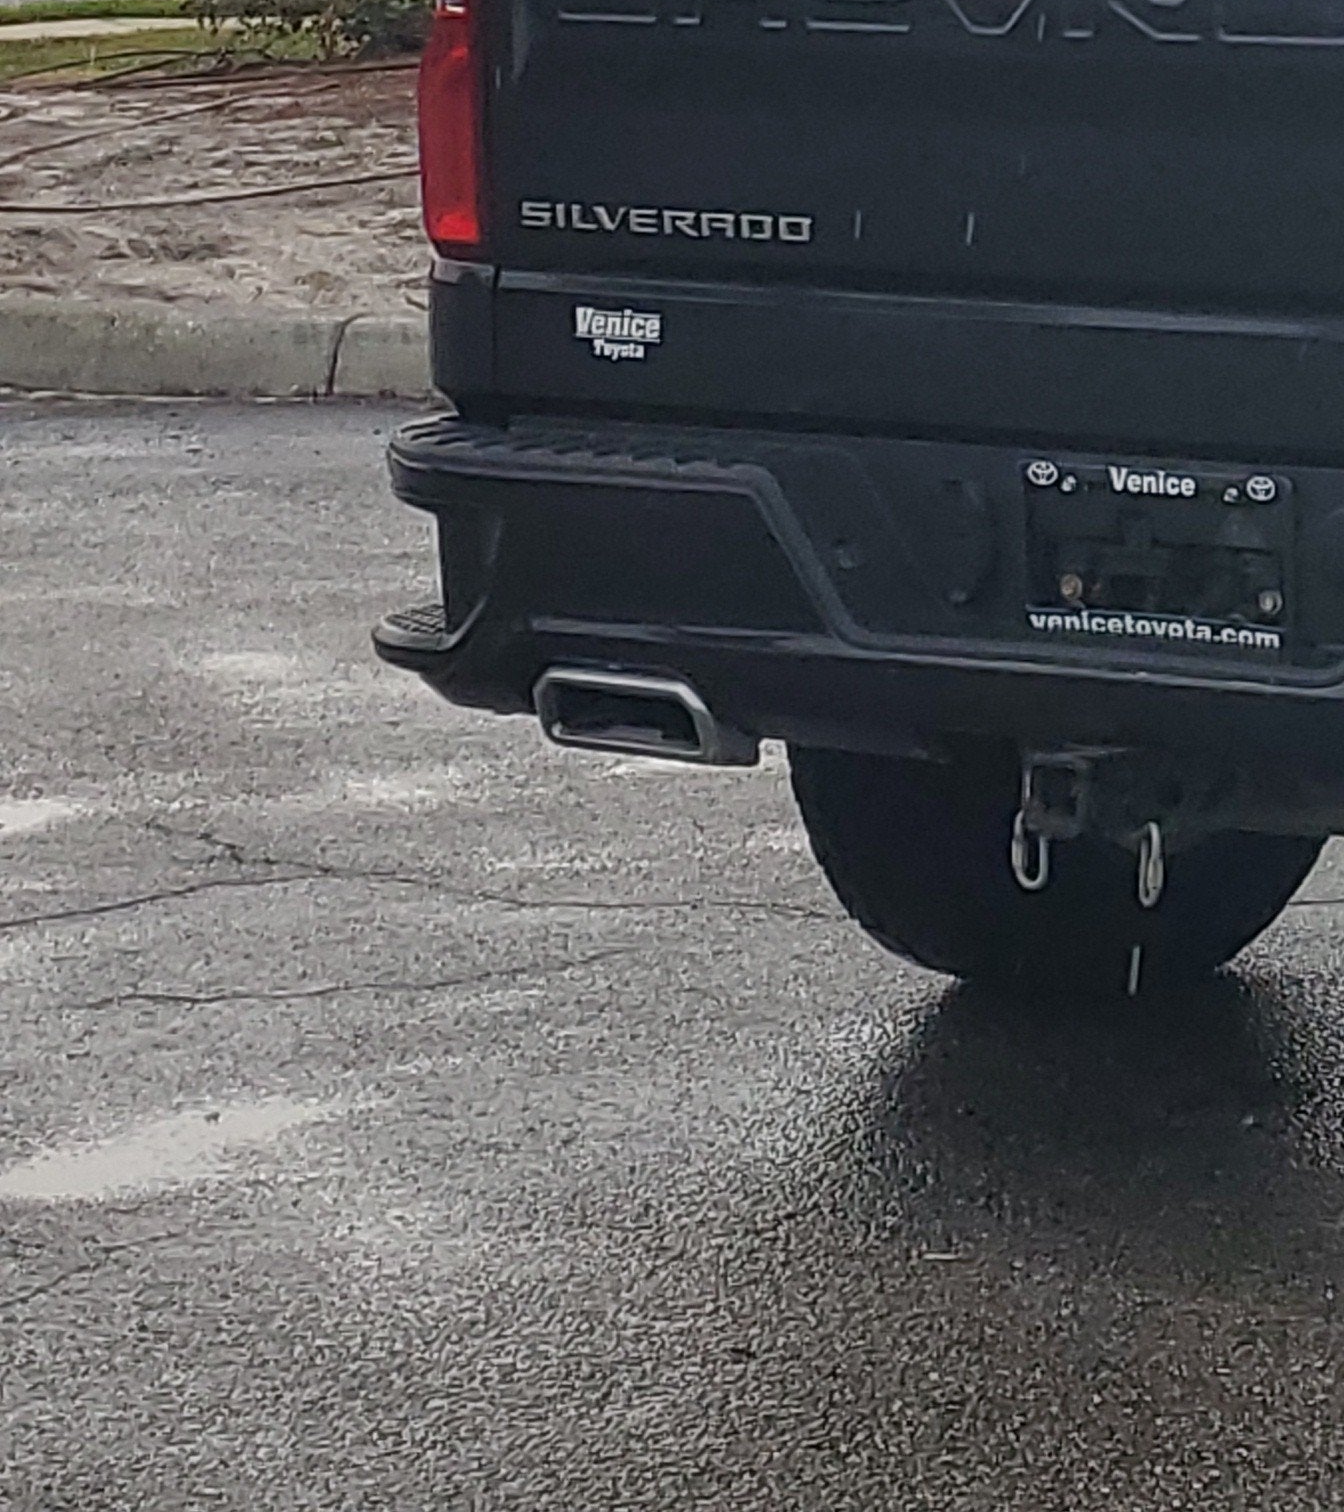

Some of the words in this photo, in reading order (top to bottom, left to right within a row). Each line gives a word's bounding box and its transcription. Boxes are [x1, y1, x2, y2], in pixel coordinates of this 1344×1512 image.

[519, 199, 813, 243] SILVERADO
[574, 306, 662, 340] Venice
[593, 339, 646, 361] Toyota
[1107, 466, 1197, 497] Venice
[1028, 611, 1282, 649] venicetoyota.com
